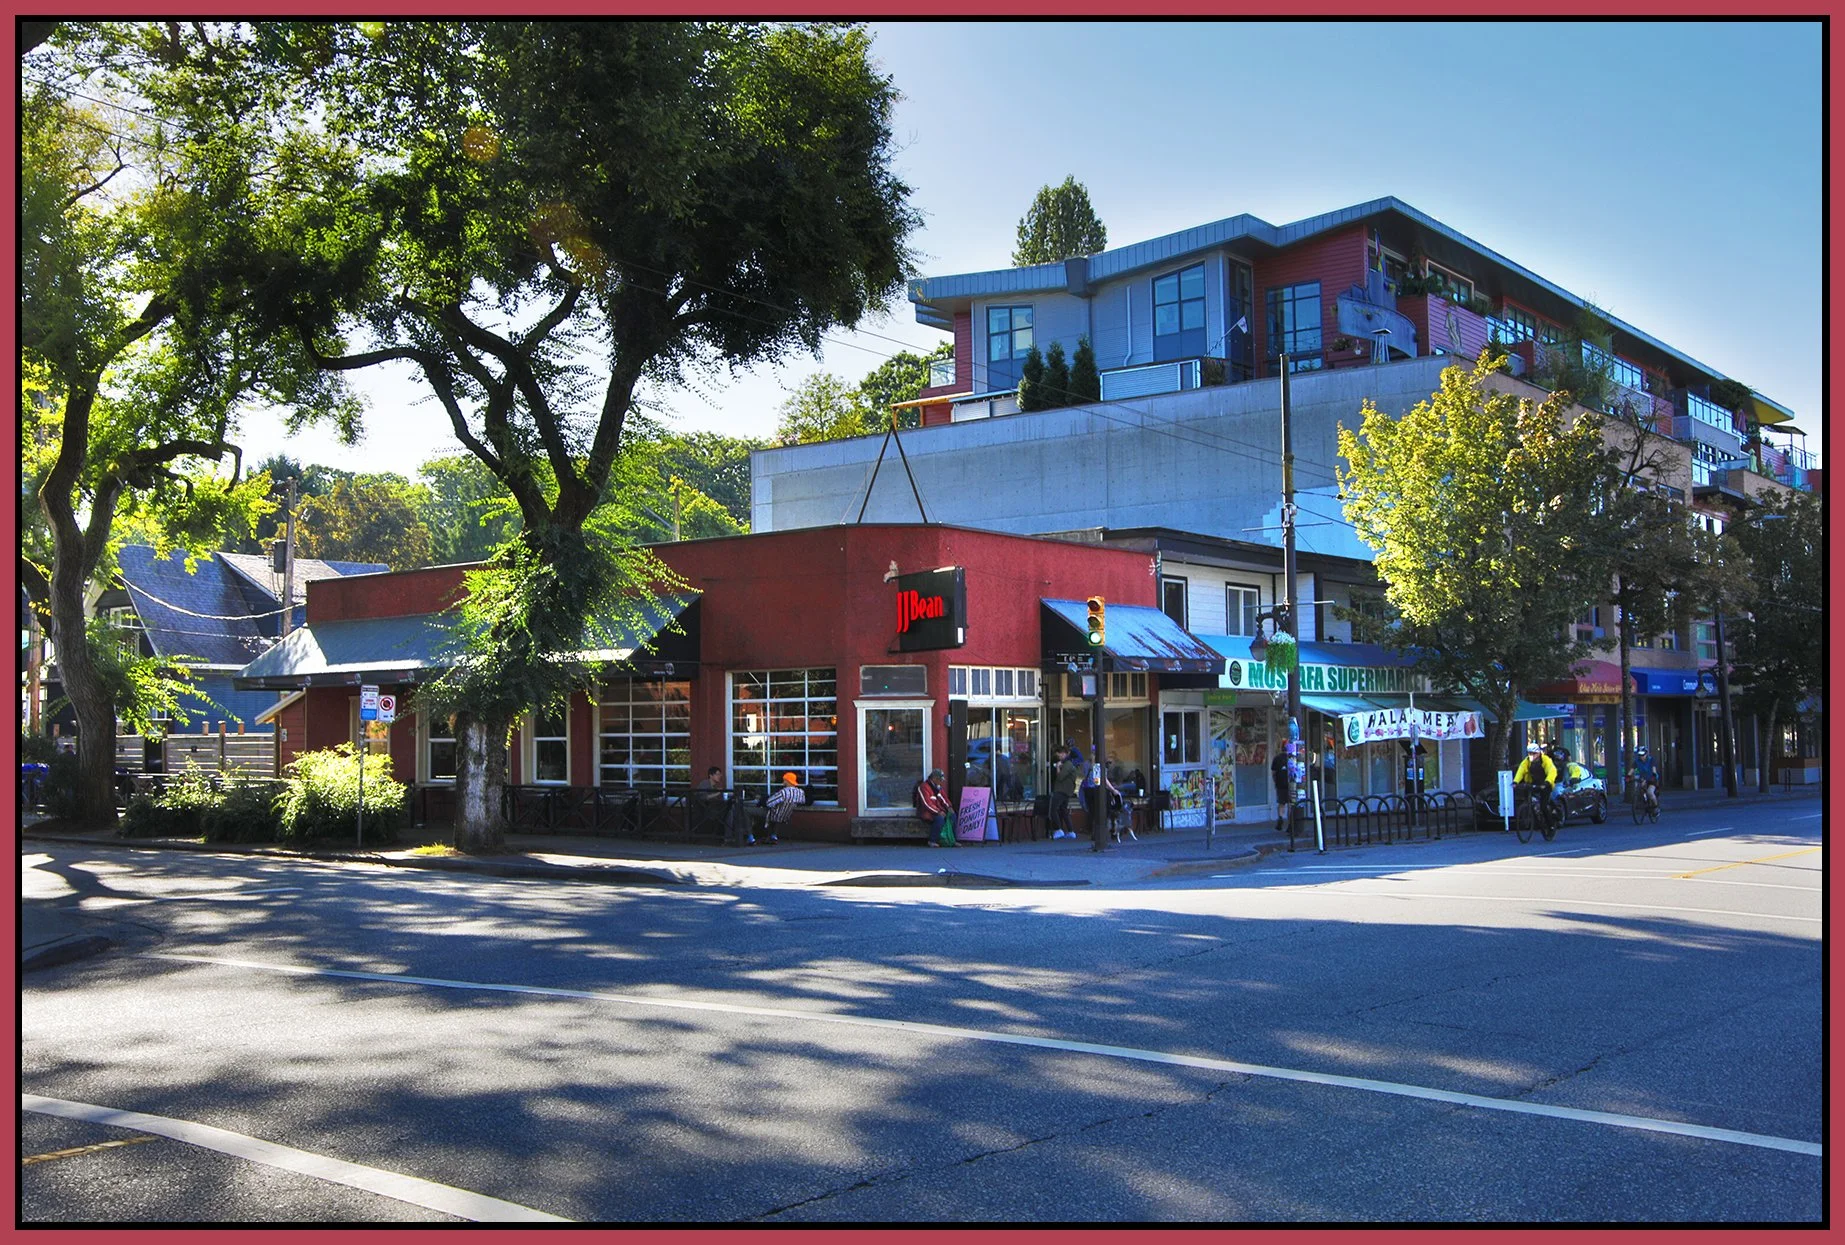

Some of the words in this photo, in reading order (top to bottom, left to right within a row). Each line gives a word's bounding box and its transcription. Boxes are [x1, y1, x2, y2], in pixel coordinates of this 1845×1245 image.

[1248, 662, 1324, 690] MOSAFA
[1368, 710, 1416, 728] HALA
[1423, 711, 1459, 727] MEA
[959, 807, 985, 826] DONUTS
